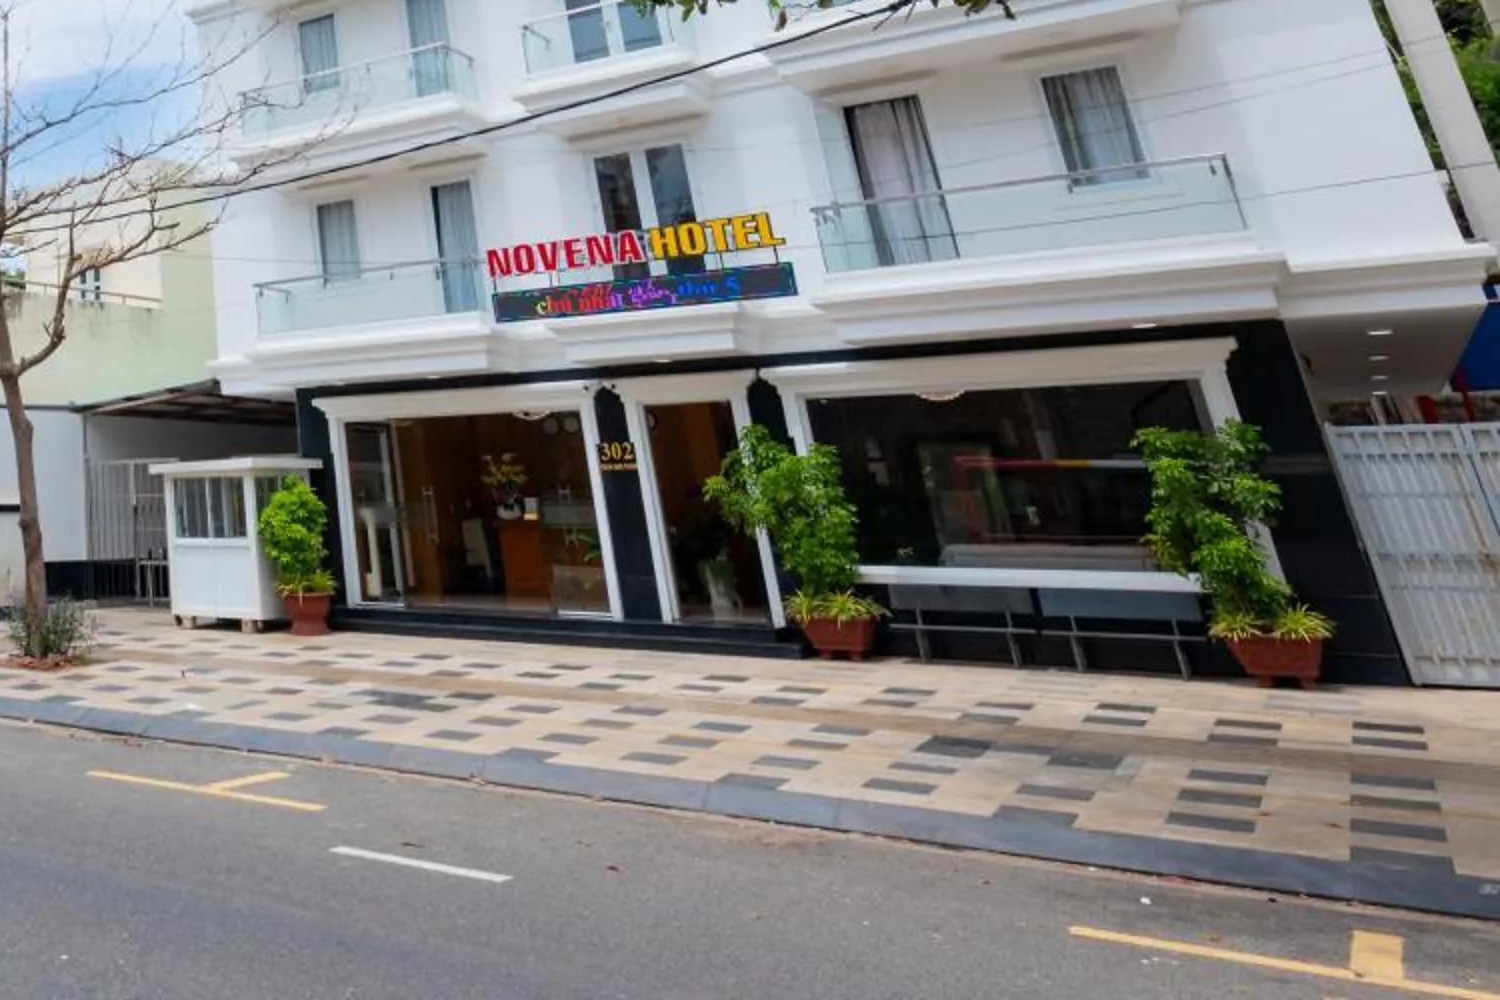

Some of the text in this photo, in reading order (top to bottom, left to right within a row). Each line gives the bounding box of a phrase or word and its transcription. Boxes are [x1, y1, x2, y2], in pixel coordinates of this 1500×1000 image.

[486, 211, 787, 279] NOVENA HOTEL
[600, 441, 635, 461] 302
